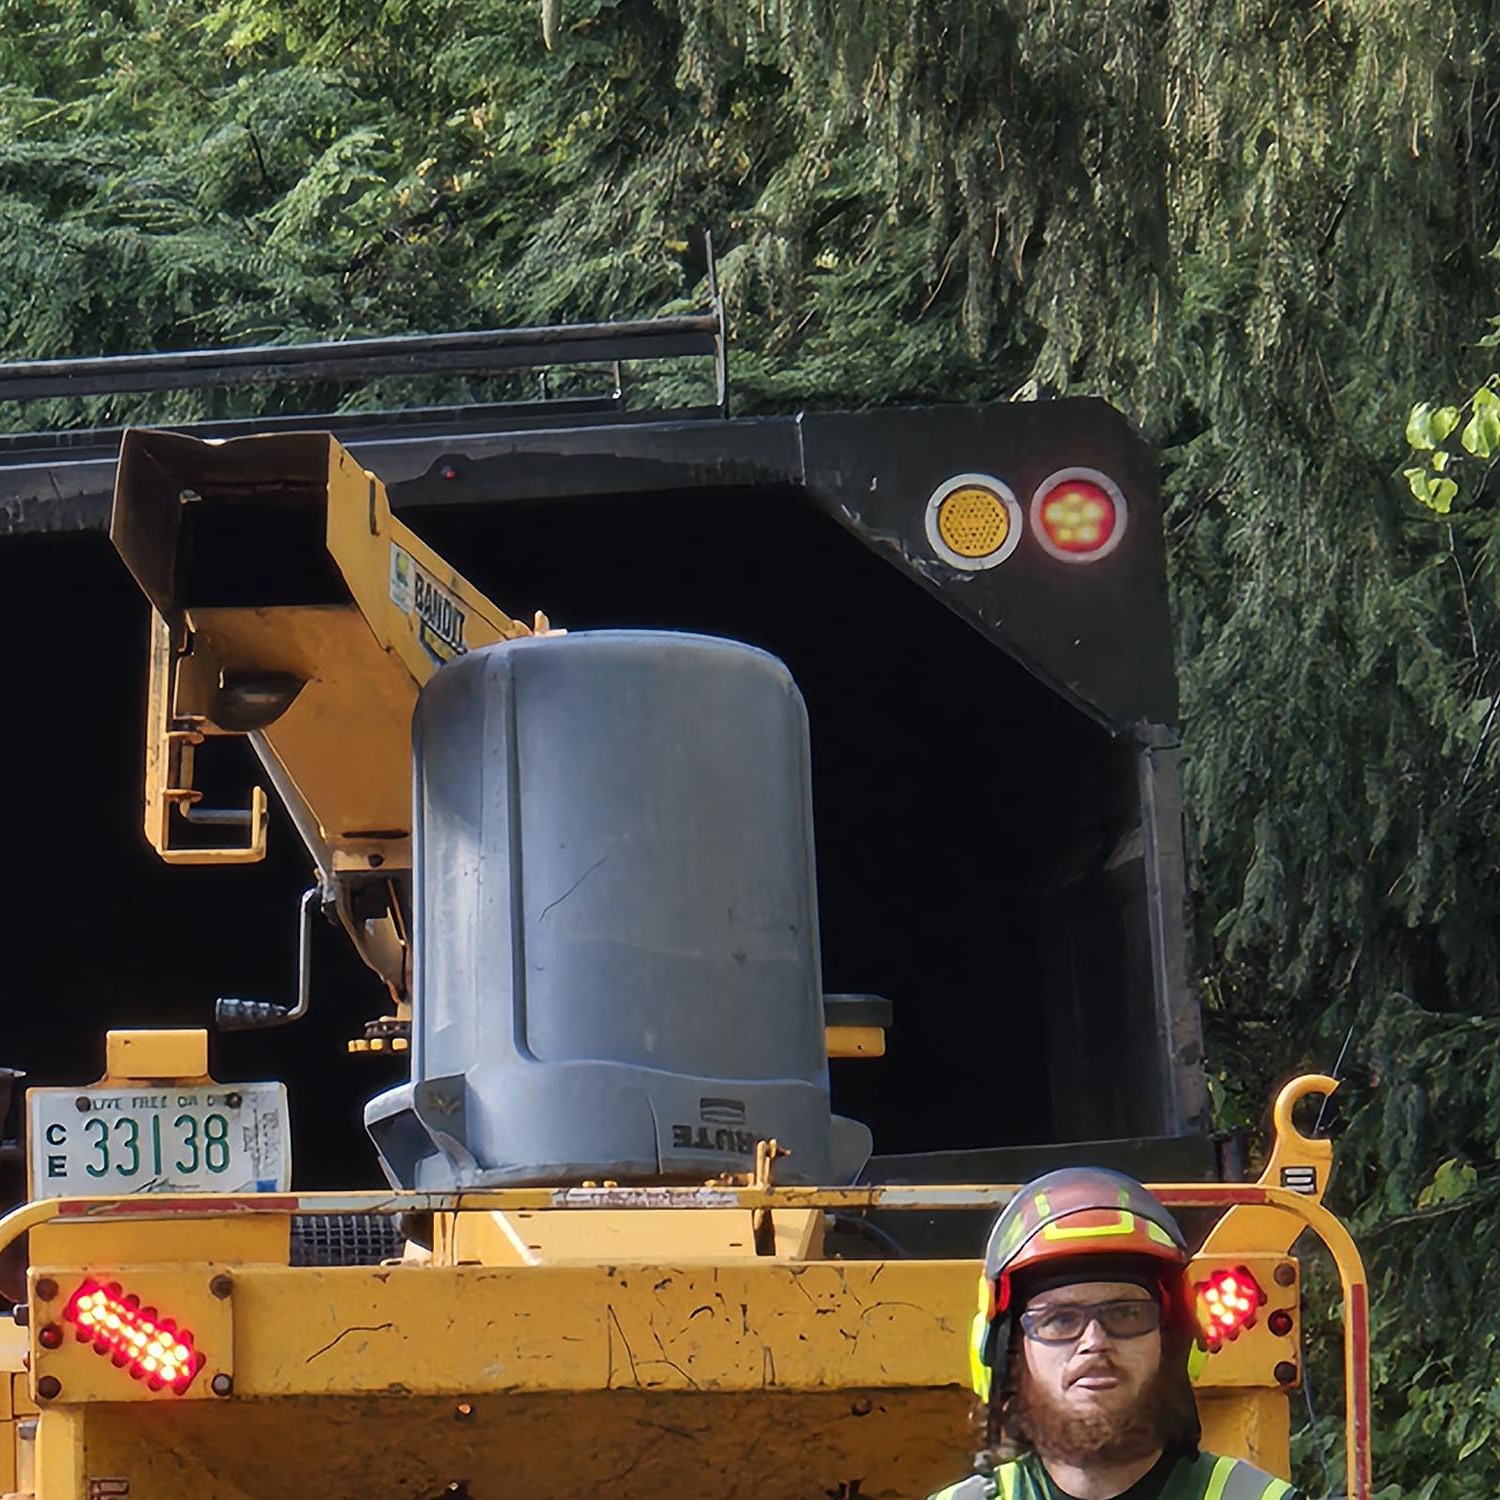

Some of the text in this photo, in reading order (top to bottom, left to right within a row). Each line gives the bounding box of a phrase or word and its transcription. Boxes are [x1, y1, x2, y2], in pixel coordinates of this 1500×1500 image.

[414, 571, 466, 649] BANDIT
[132, 1094, 167, 1110] FREE
[177, 1094, 198, 1108] OR
[84, 1113, 231, 1178] 33138
[672, 1124, 757, 1156] RUTE
